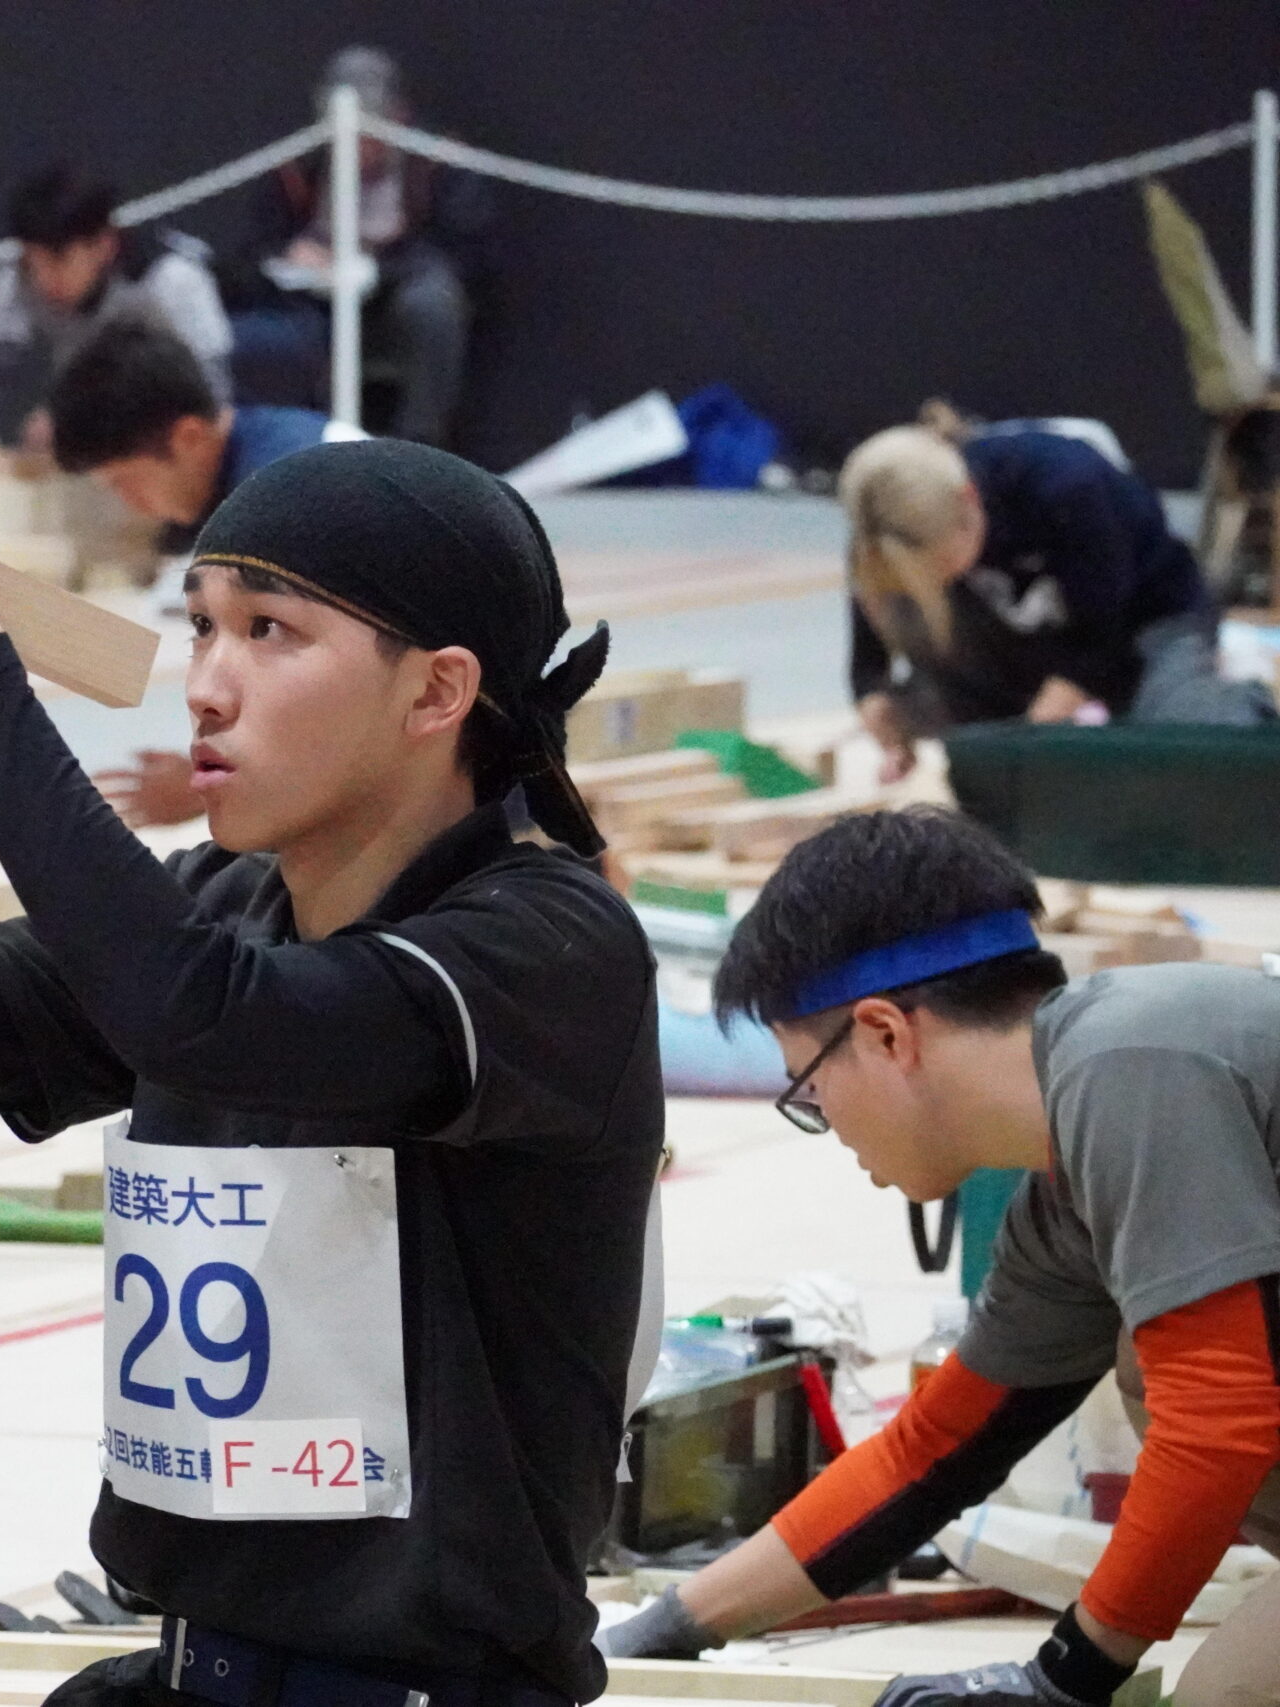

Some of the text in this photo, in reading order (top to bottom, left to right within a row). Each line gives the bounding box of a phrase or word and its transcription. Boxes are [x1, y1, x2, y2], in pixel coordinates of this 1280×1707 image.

[108, 1165, 267, 1229] 建築大工
[114, 1252, 271, 1419] 29
